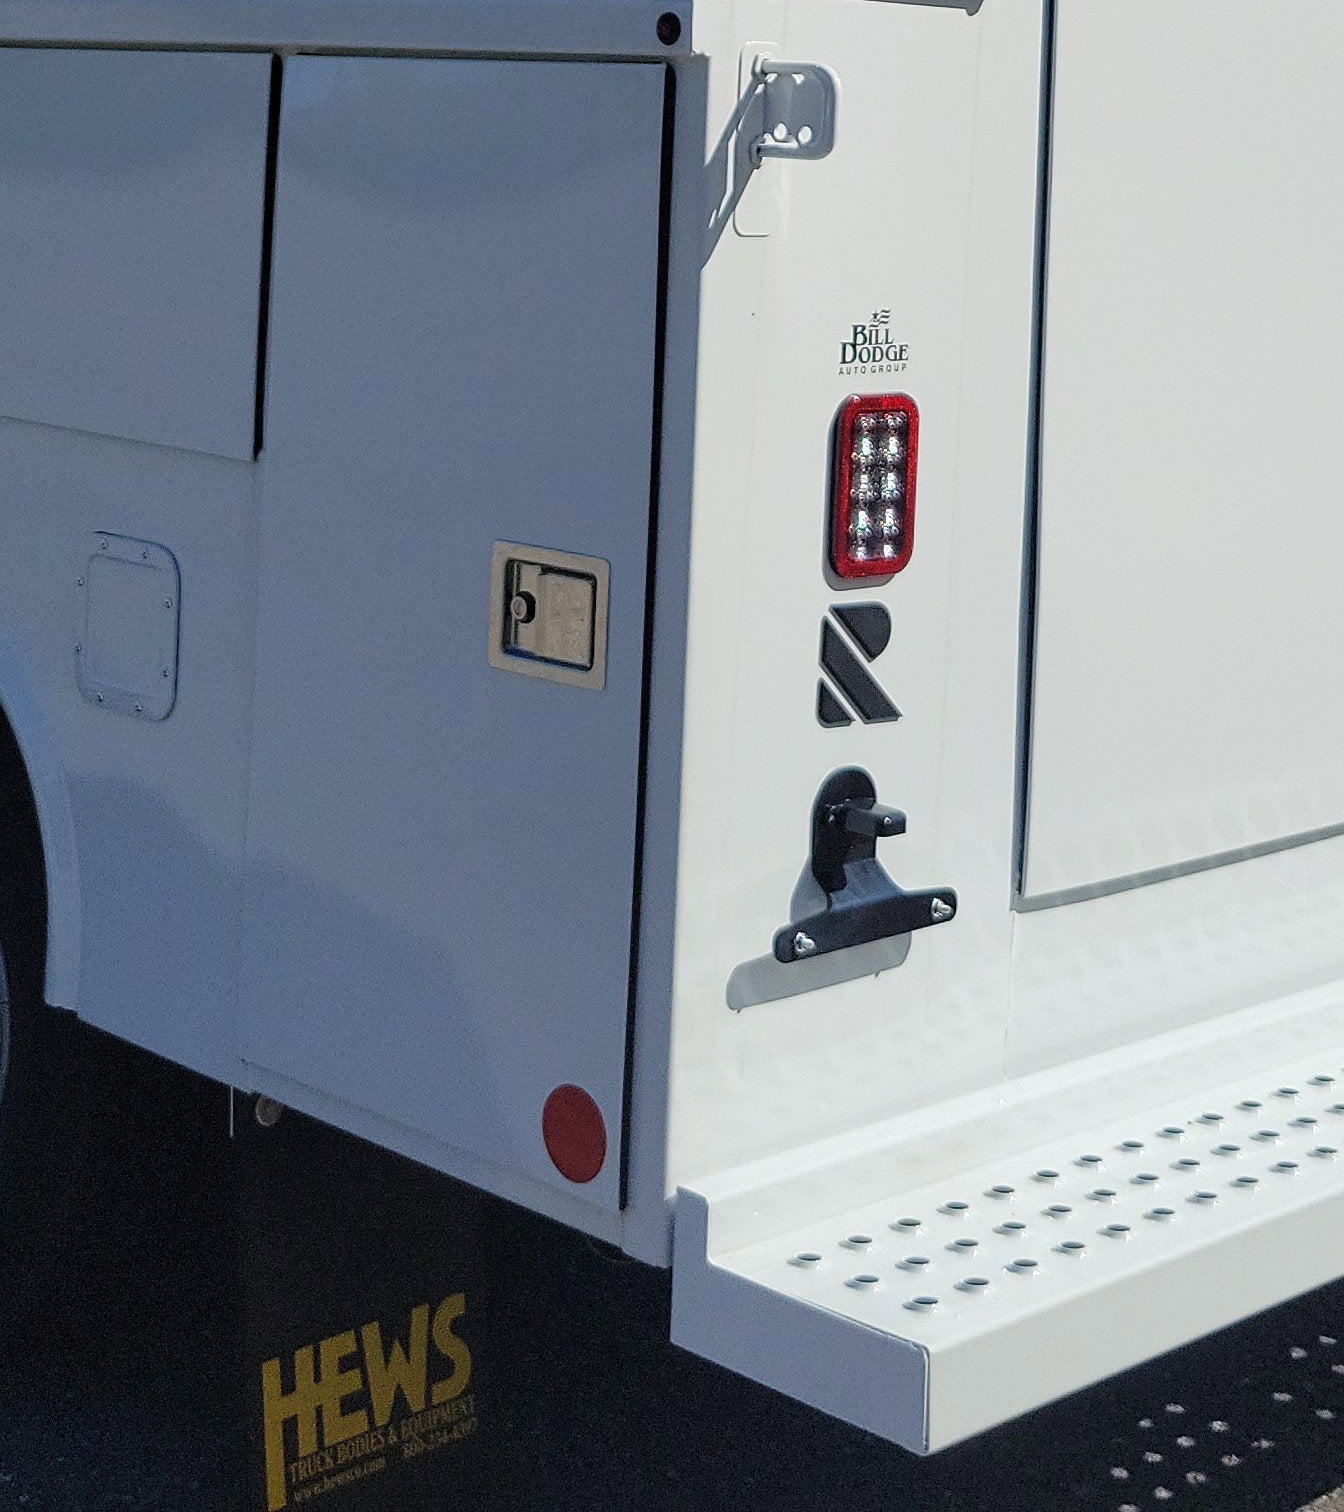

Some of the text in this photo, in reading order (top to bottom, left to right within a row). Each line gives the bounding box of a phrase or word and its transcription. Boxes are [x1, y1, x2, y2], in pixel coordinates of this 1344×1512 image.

[852, 324, 894, 346] BILL
[839, 342, 909, 364] DODGE
[838, 363, 907, 375] AUTO GROUP
[262, 1292, 473, 1512] HEWS
[289, 1446, 335, 1484] TRUCK
[337, 1430, 386, 1466] BODIES
